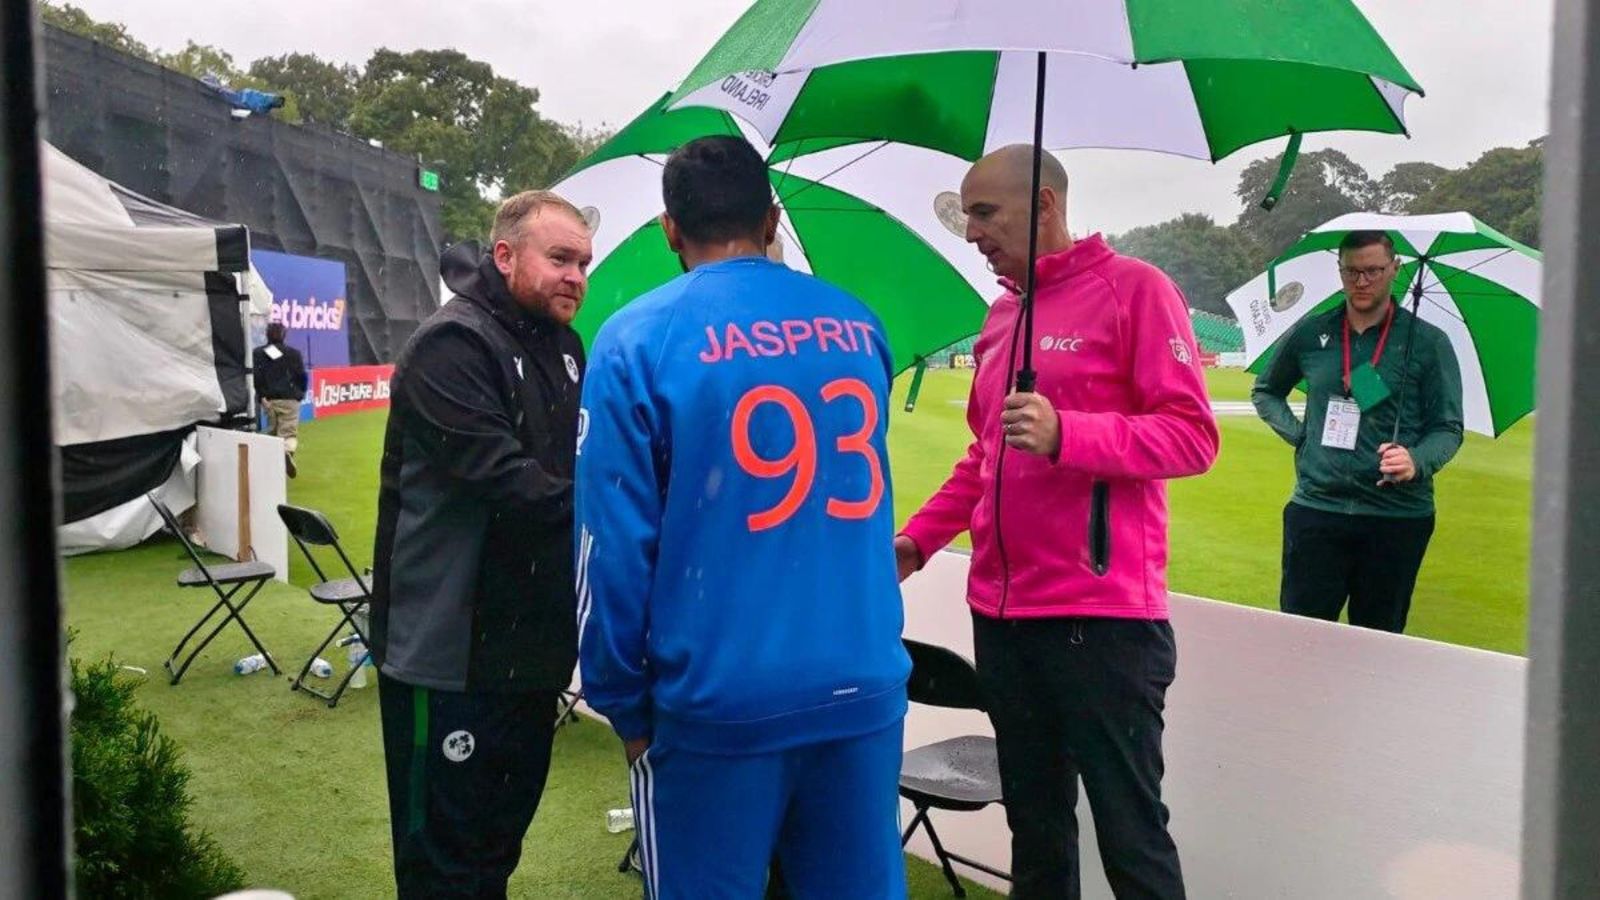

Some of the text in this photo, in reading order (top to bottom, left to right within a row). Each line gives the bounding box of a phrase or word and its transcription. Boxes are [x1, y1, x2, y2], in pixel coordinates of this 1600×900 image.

[271, 298, 290, 328] et
[700, 316, 874, 363] JASPRIT
[1054, 338, 1083, 351] ICC
[731, 377, 885, 533] 93
